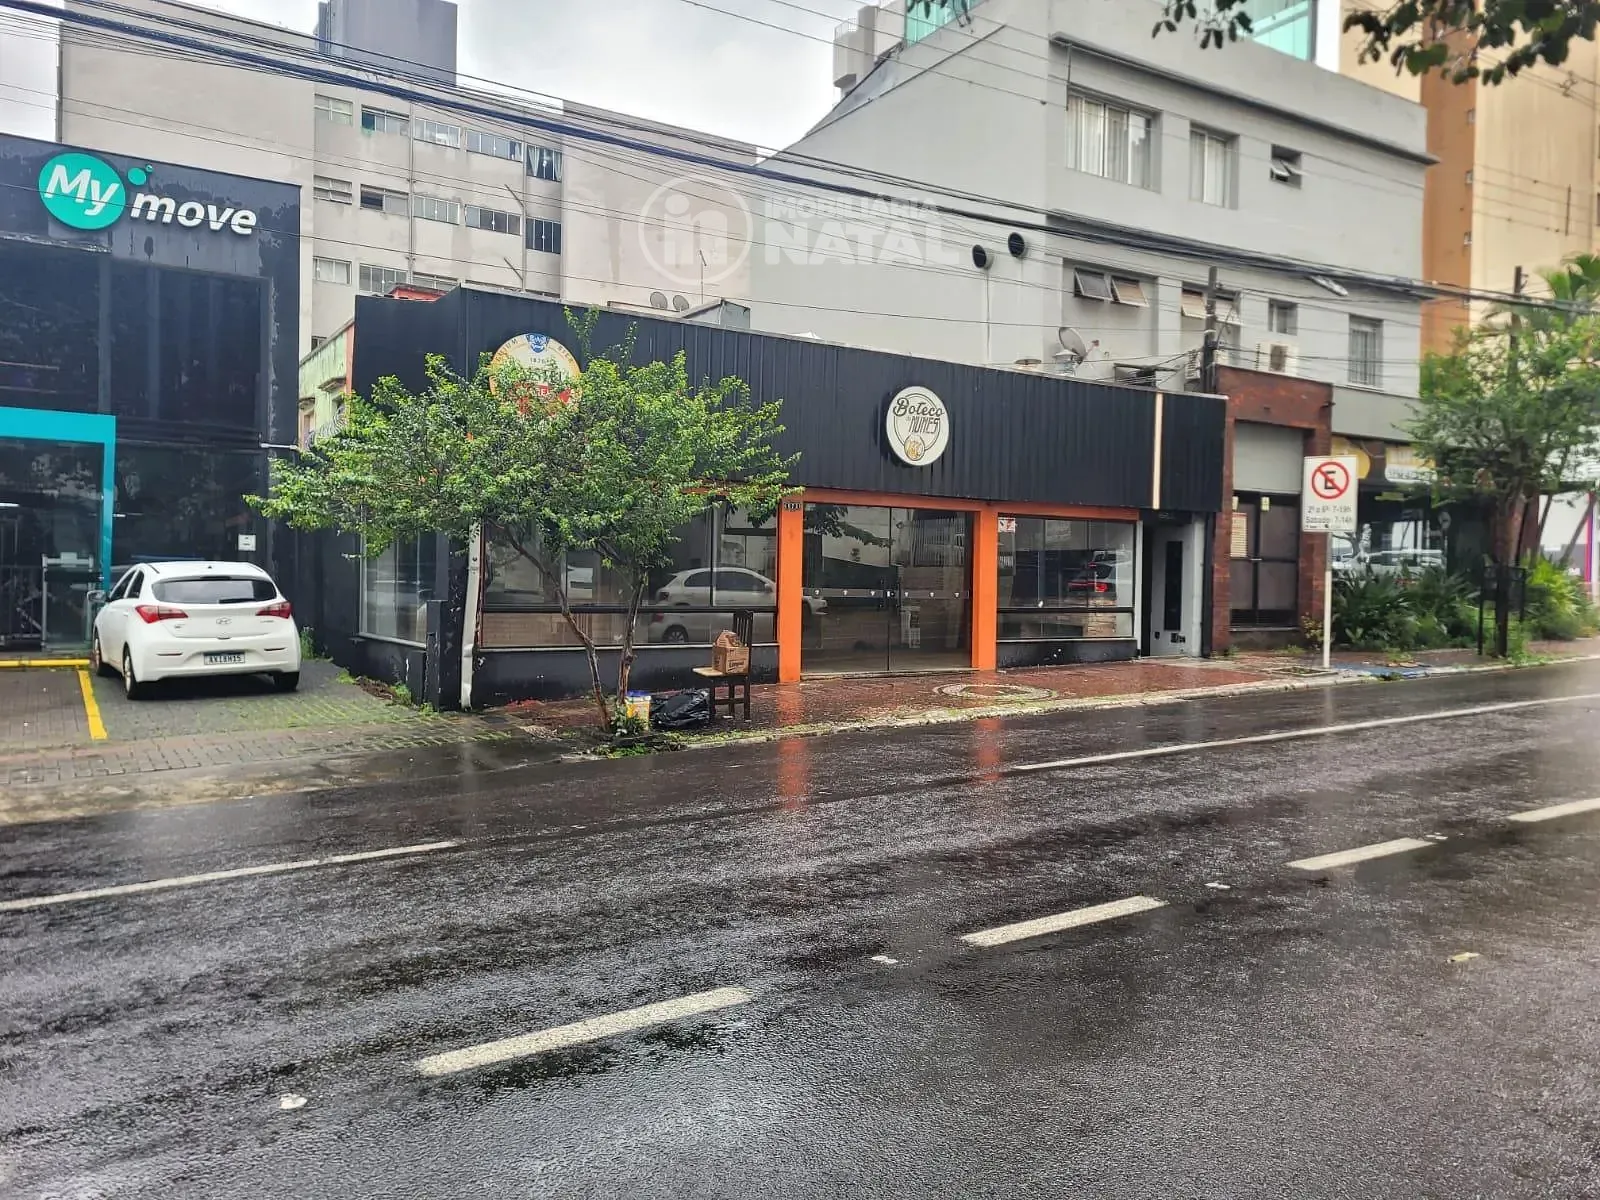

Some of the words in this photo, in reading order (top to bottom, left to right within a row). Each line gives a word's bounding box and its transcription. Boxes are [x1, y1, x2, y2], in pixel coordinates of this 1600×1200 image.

[44, 164, 119, 217] My
[130, 192, 257, 236] move
[893, 397, 944, 417] Boteco
